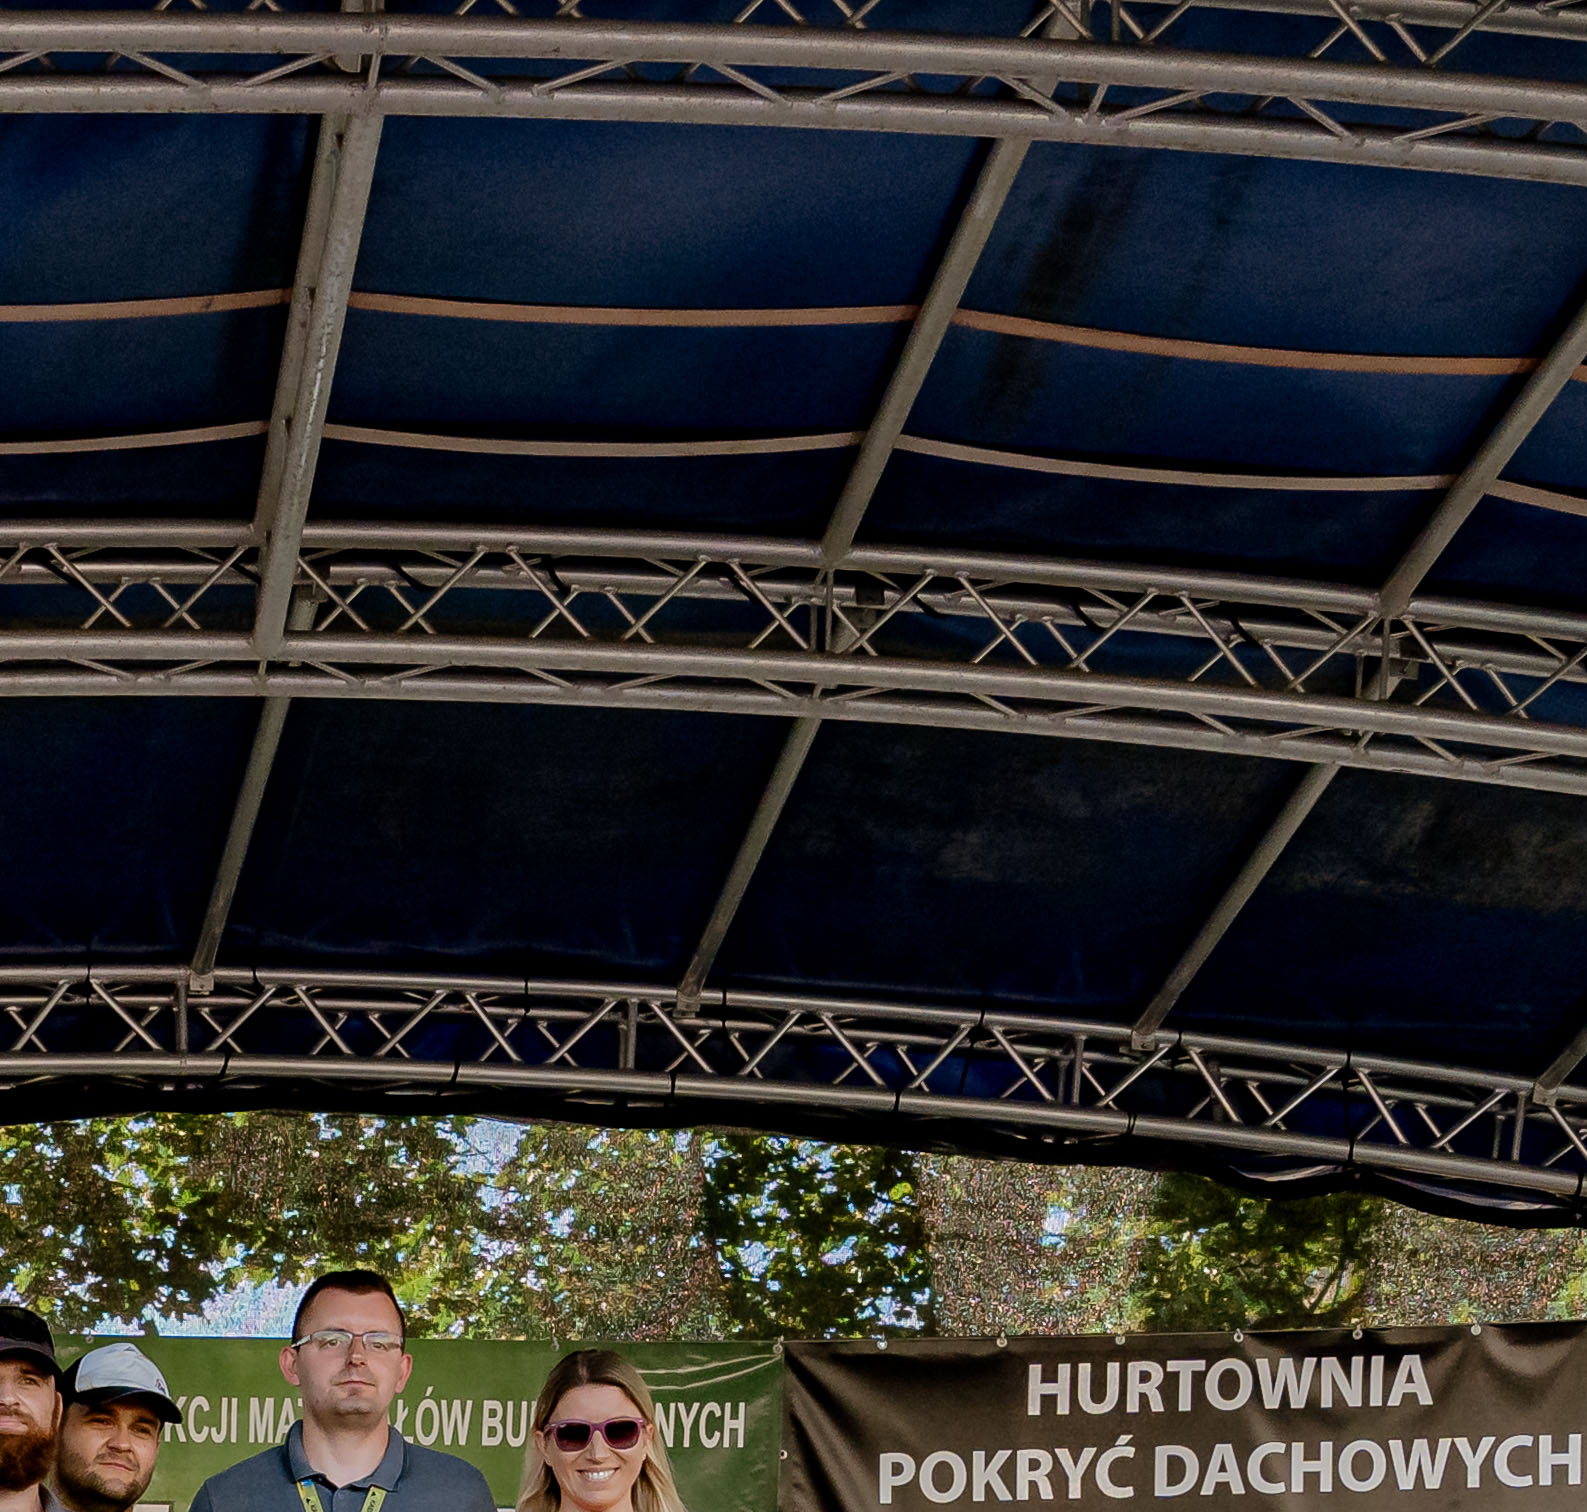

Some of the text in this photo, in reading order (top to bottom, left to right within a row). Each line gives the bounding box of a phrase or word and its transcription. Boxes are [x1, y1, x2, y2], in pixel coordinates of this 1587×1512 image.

[1026, 1354, 1434, 1417] HURTOWNIA
[878, 1433, 1584, 1505] POKRYĆ DACHOWYCH
